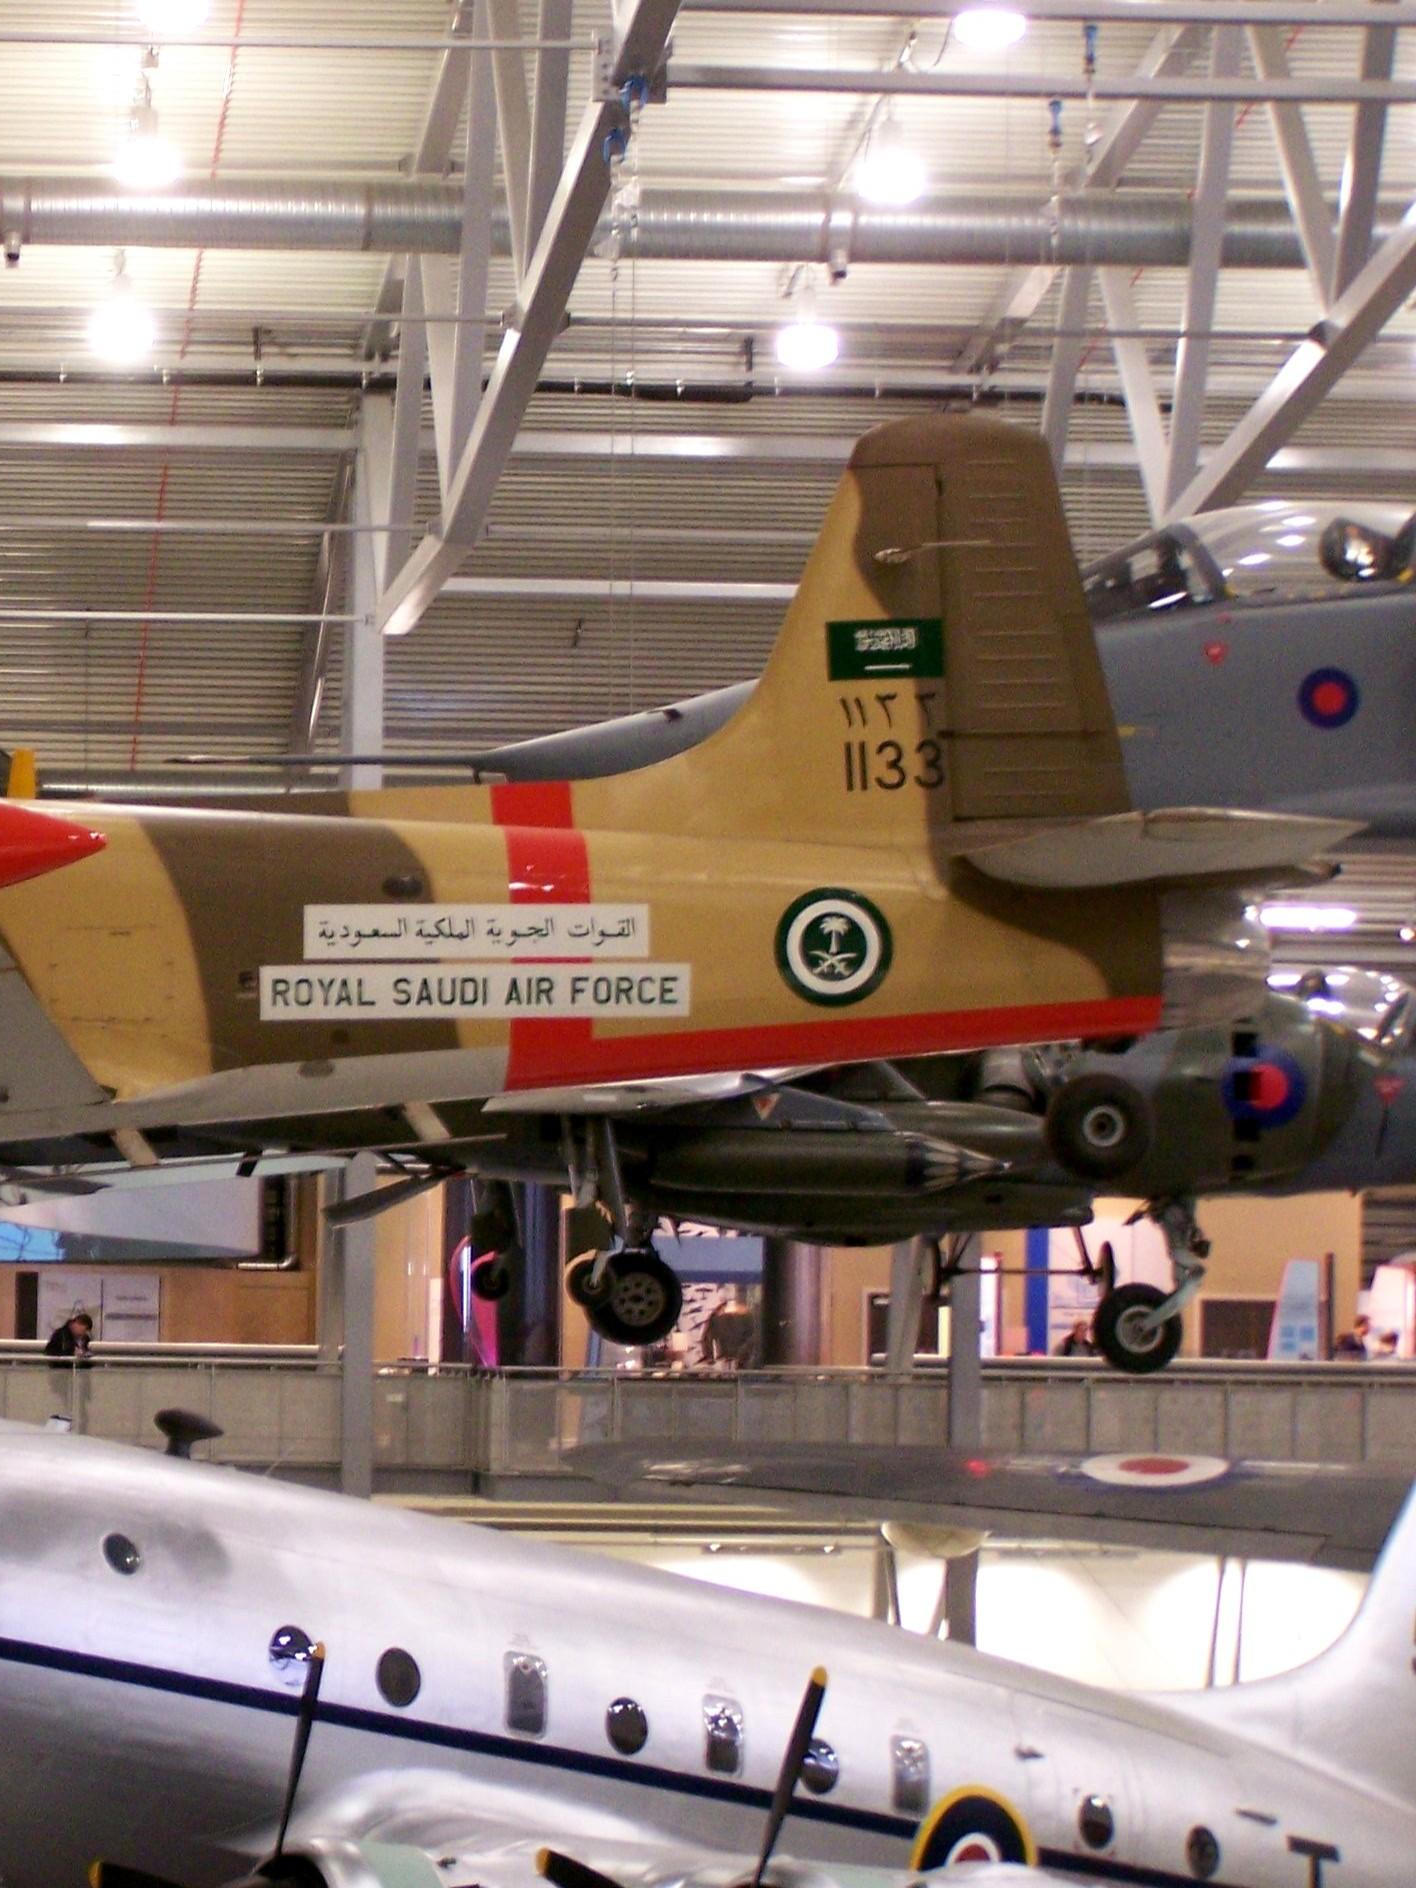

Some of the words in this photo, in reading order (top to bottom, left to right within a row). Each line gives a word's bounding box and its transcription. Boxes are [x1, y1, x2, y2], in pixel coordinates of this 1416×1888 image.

[845, 740, 945, 791] 1133
[271, 978, 376, 1007] ROYAL
[392, 977, 489, 1005] SAUDI
[504, 976, 555, 1004] AIR
[570, 976, 680, 1004] FORCE
